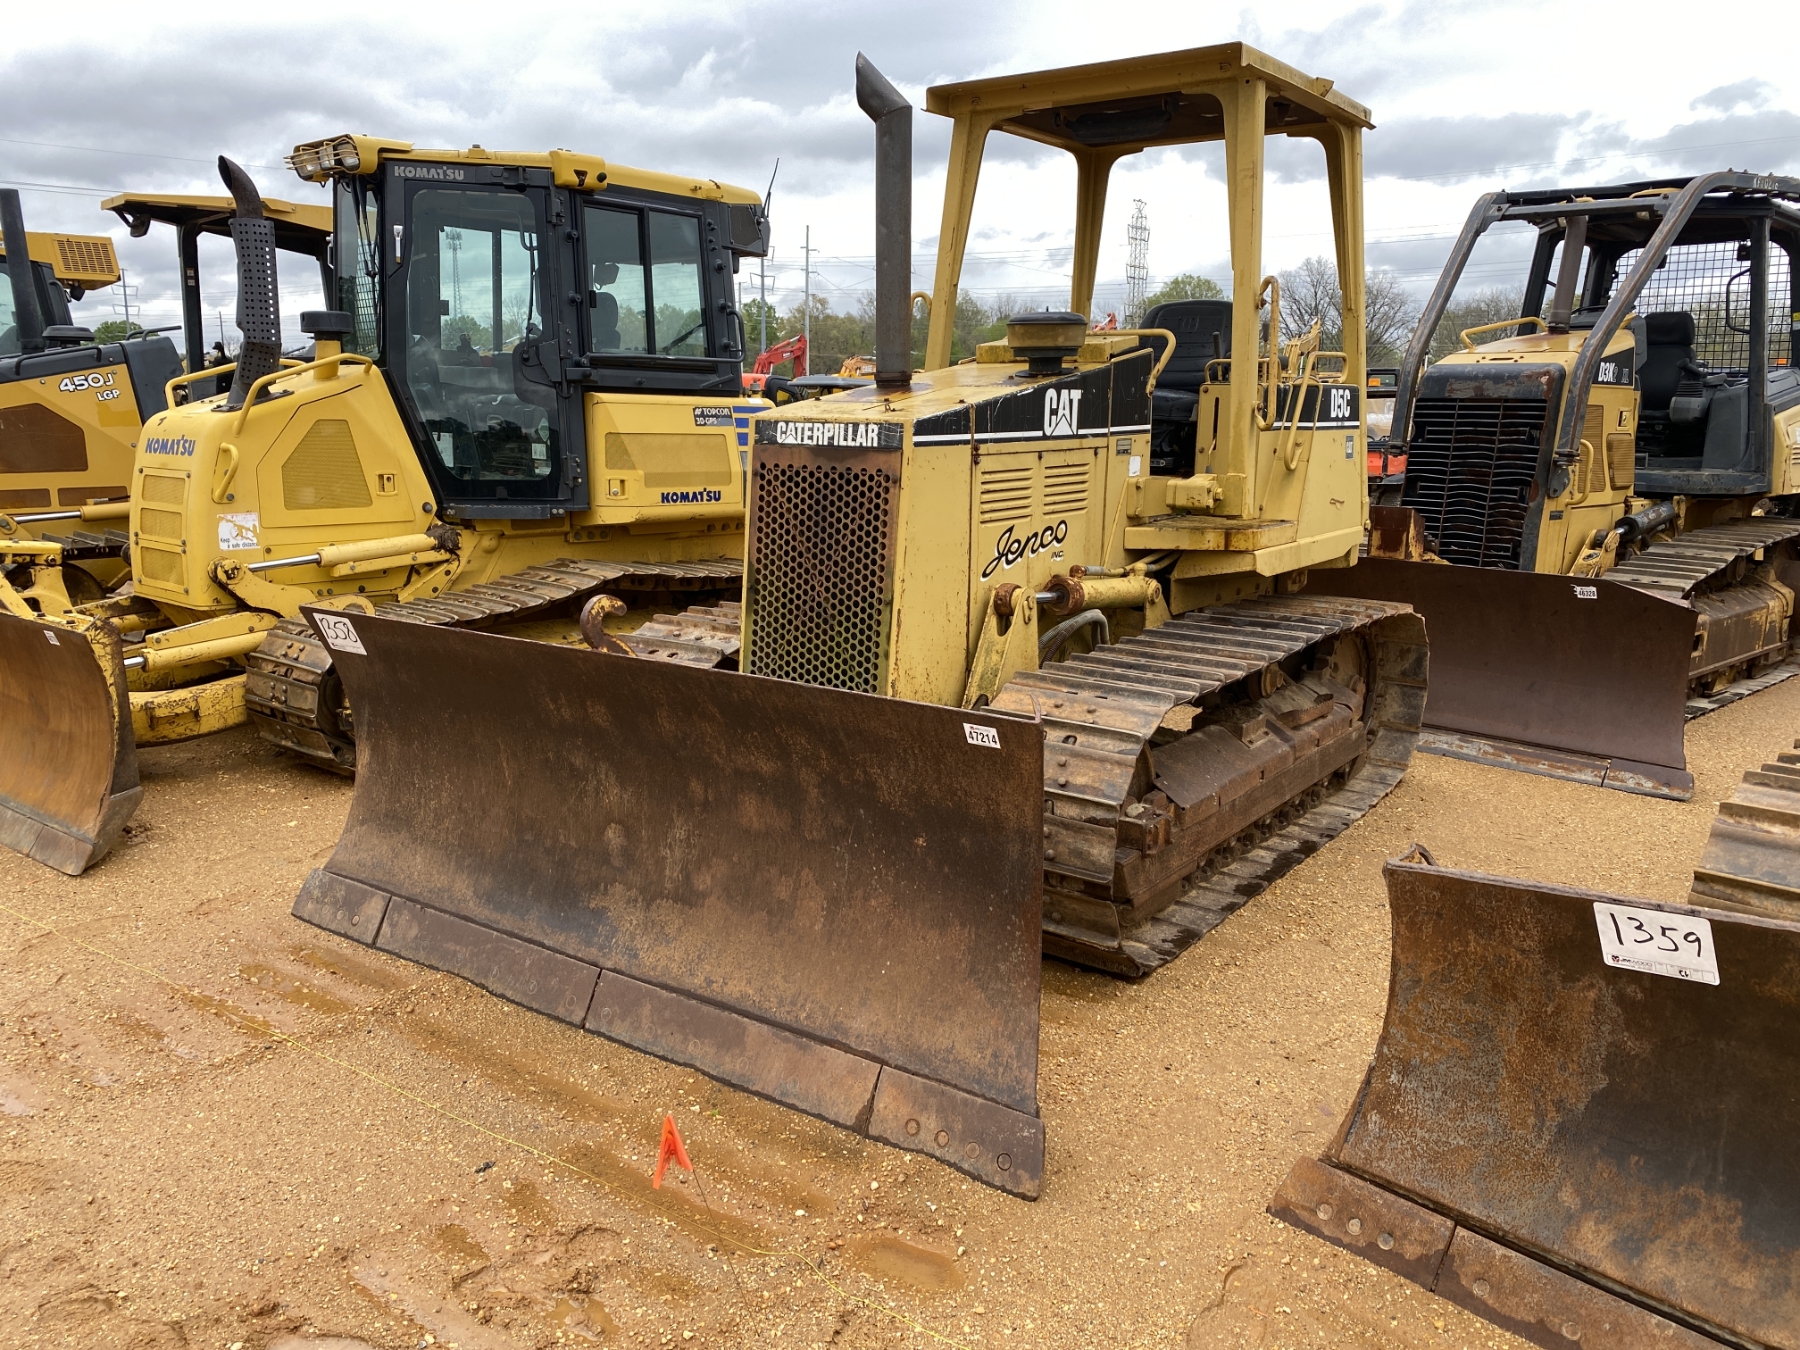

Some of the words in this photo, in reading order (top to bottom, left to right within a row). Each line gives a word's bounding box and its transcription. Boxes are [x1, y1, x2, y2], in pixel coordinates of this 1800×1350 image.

[394, 165, 464, 180] KOMATSU
[59, 373, 114, 392] 450J
[96, 389, 120, 401] LGP
[1331, 388, 1351, 418] D5C
[1044, 388, 1082, 437] CAT
[145, 434, 196, 456] KOMATSU
[776, 420, 879, 447] CATERPILLAR
[660, 487, 722, 504] KOMATSU
[980, 519, 1068, 582] Jenco
[318, 617, 358, 643] 1358
[968, 730, 998, 745] 47214
[1609, 912, 1702, 957] 1359
